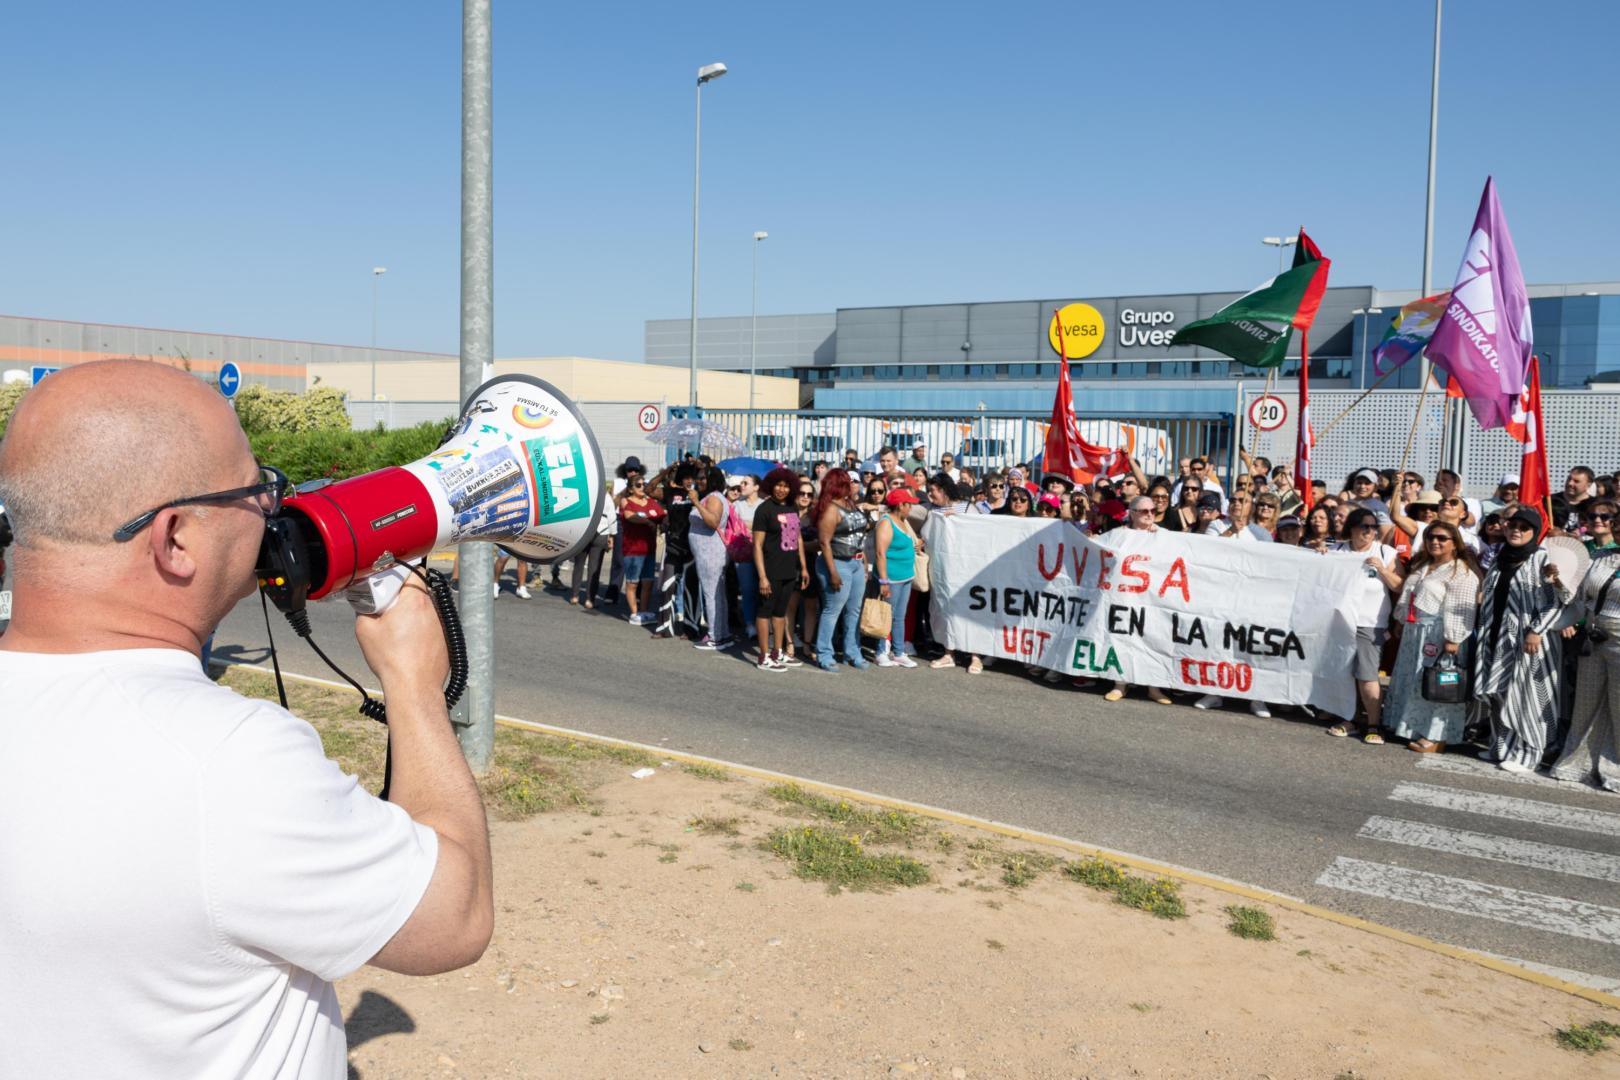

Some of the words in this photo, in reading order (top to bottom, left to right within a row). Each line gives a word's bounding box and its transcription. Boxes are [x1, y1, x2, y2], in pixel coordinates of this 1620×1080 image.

[1120, 326, 1177, 346] Uves
[1121, 309, 1175, 327] Grupo
[1447, 303, 1500, 374] SINDIKATU
[516, 396, 540, 408] MISMA
[539, 404, 549, 412] TU
[644, 412, 655, 424] 20
[1259, 405, 1278, 420] 20
[533, 447, 545, 476] EUSKAL
[540, 476, 551, 517] SINDIKATUA
[542, 441, 580, 514] ELA
[1037, 543, 1190, 603] UVESA
[969, 584, 1091, 627] SIENTATE
[1108, 604, 1146, 638] EN
[1171, 612, 1209, 649] LA
[1223, 621, 1306, 661] MESA
[1002, 624, 1052, 660] UGT
[1072, 638, 1124, 674] ELA
[1180, 657, 1252, 692] CCOO
